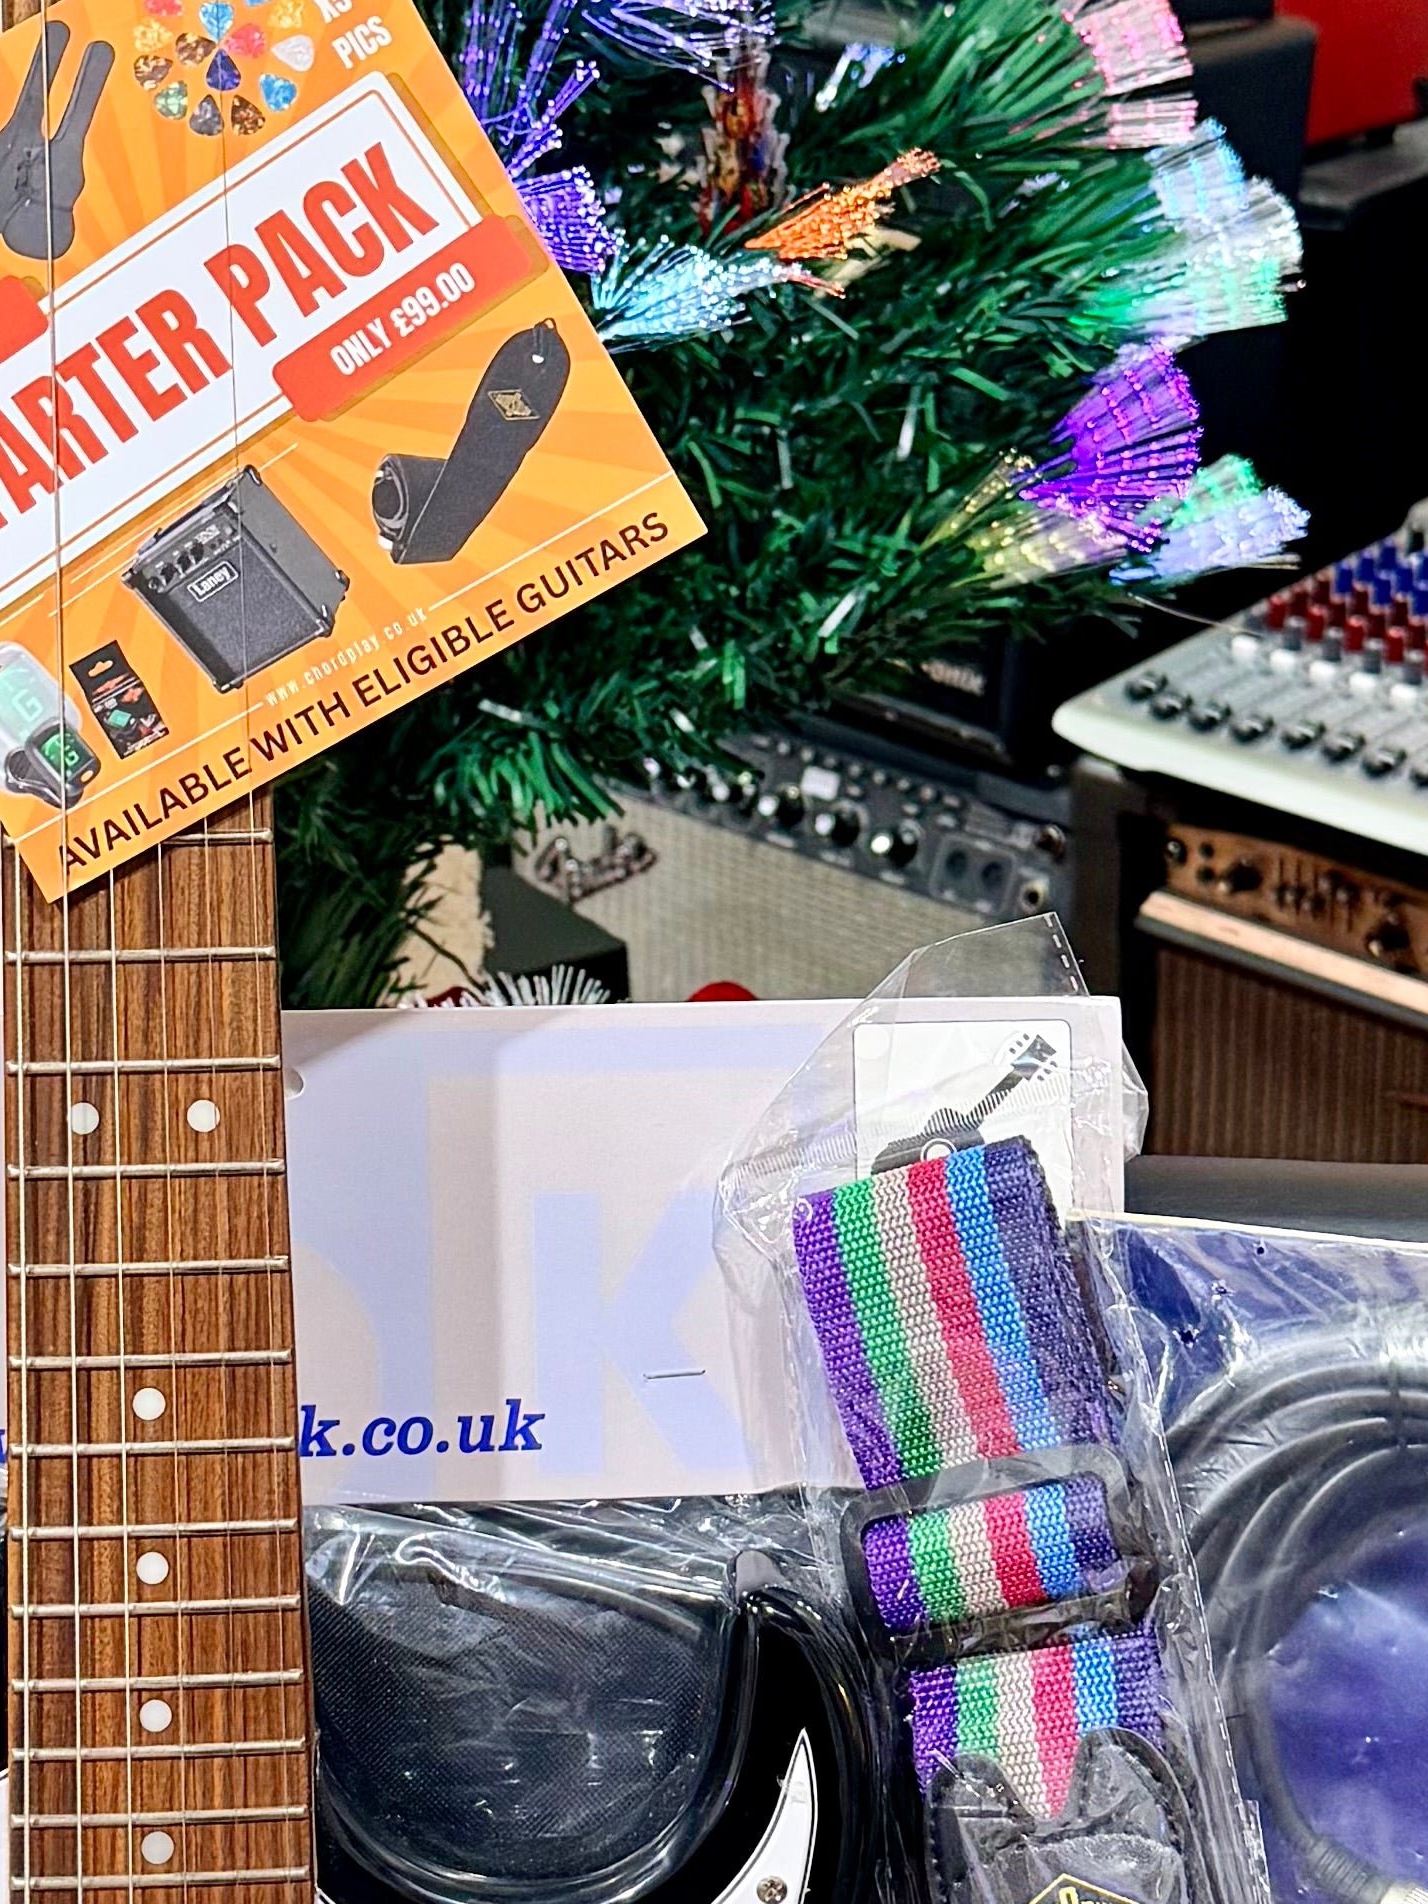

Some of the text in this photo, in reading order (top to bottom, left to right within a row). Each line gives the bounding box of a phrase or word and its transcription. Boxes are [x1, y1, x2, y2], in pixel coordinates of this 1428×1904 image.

[332, 15, 392, 70] PICS
[203, 142, 439, 348] PACK
[330, 262, 476, 377] ONLY £99.00
[191, 564, 232, 597] Laney
[56, 746, 254, 876] AVAILABLE
[250, 693, 352, 763] WITH
[357, 598, 517, 707] ELIGIBLE
[515, 511, 670, 614] GUITARS
[264, 608, 429, 707] www.chordplay.co.uk
